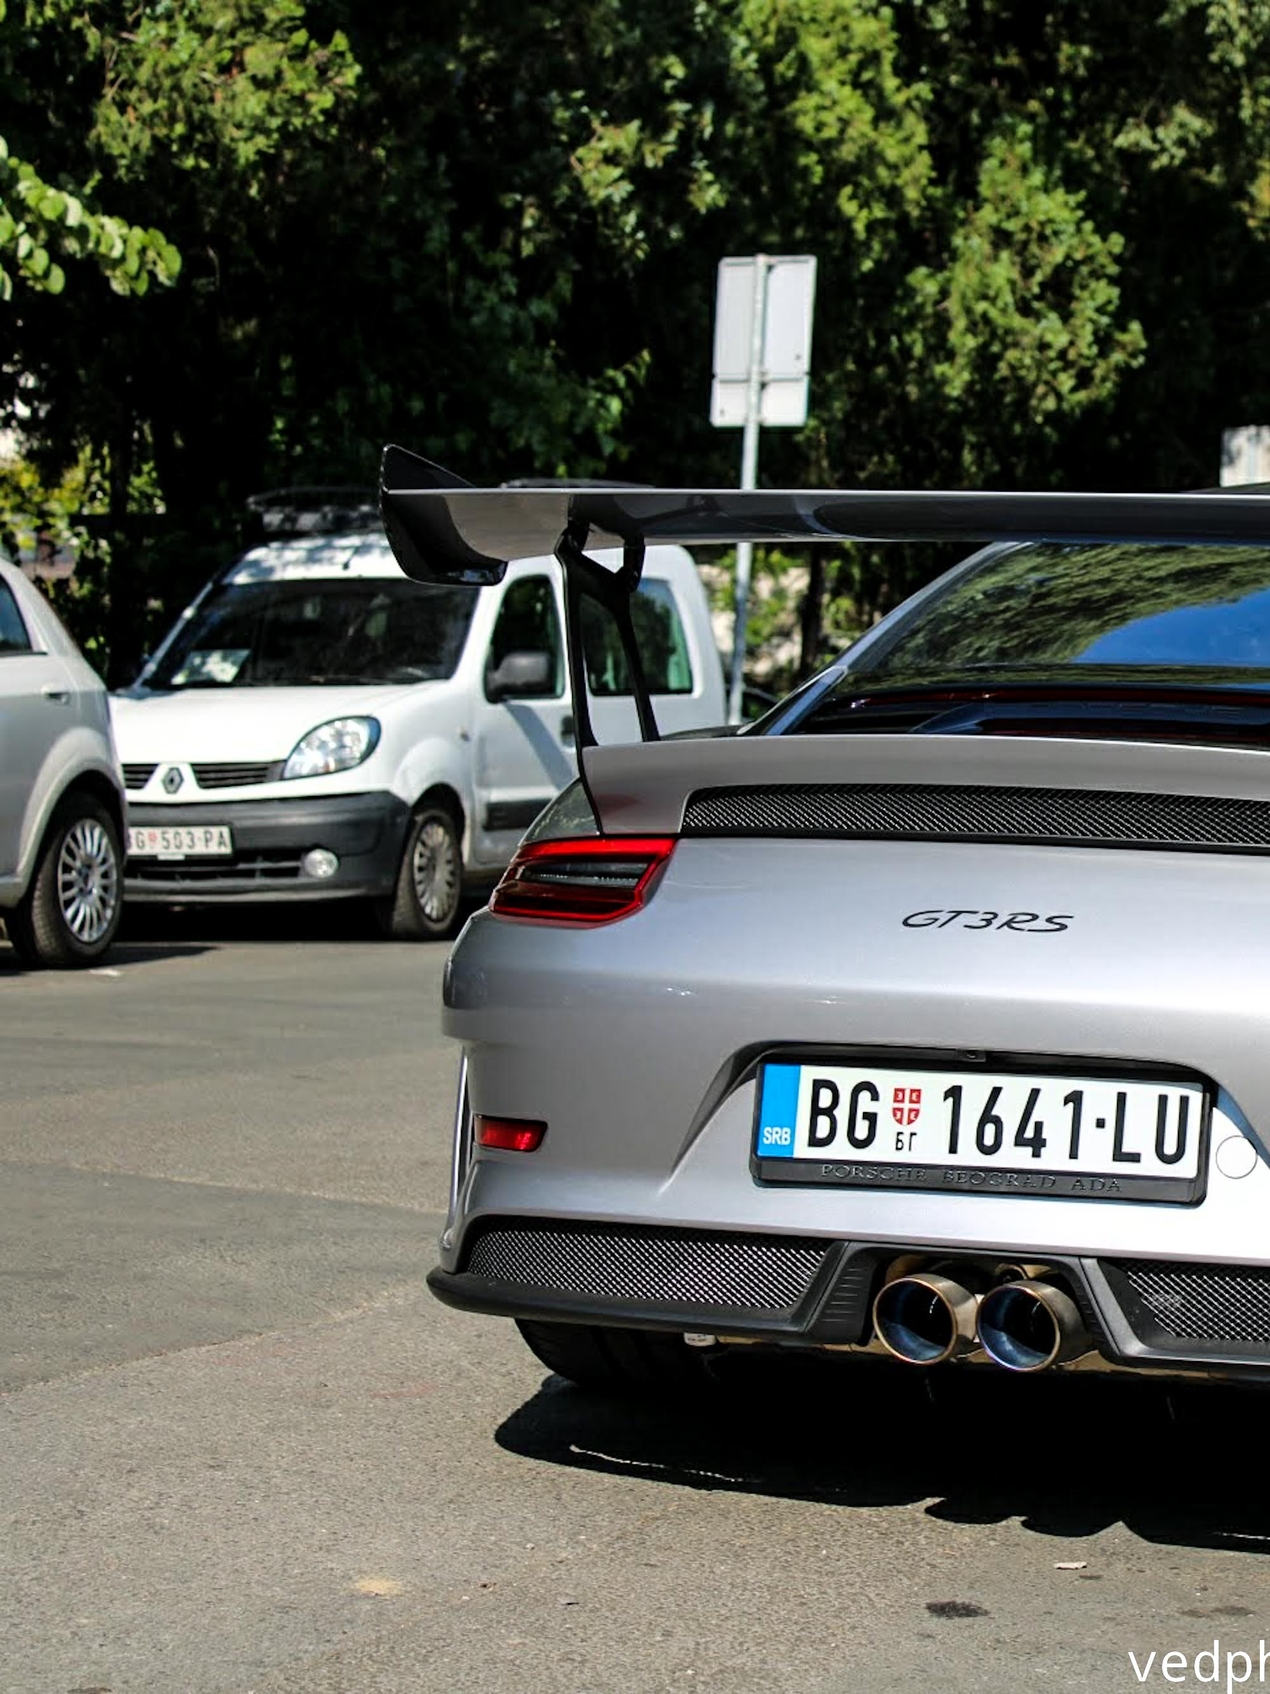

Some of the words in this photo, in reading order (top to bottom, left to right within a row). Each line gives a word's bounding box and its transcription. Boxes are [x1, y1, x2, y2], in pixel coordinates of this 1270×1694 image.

[807, 1078, 880, 1149] BG
[762, 1126, 791, 1146] SRB
[821, 1163, 926, 1184] PORSCHE
[942, 1169, 1056, 1189] BEOGRAD
[1071, 1176, 1123, 1193] ADA
